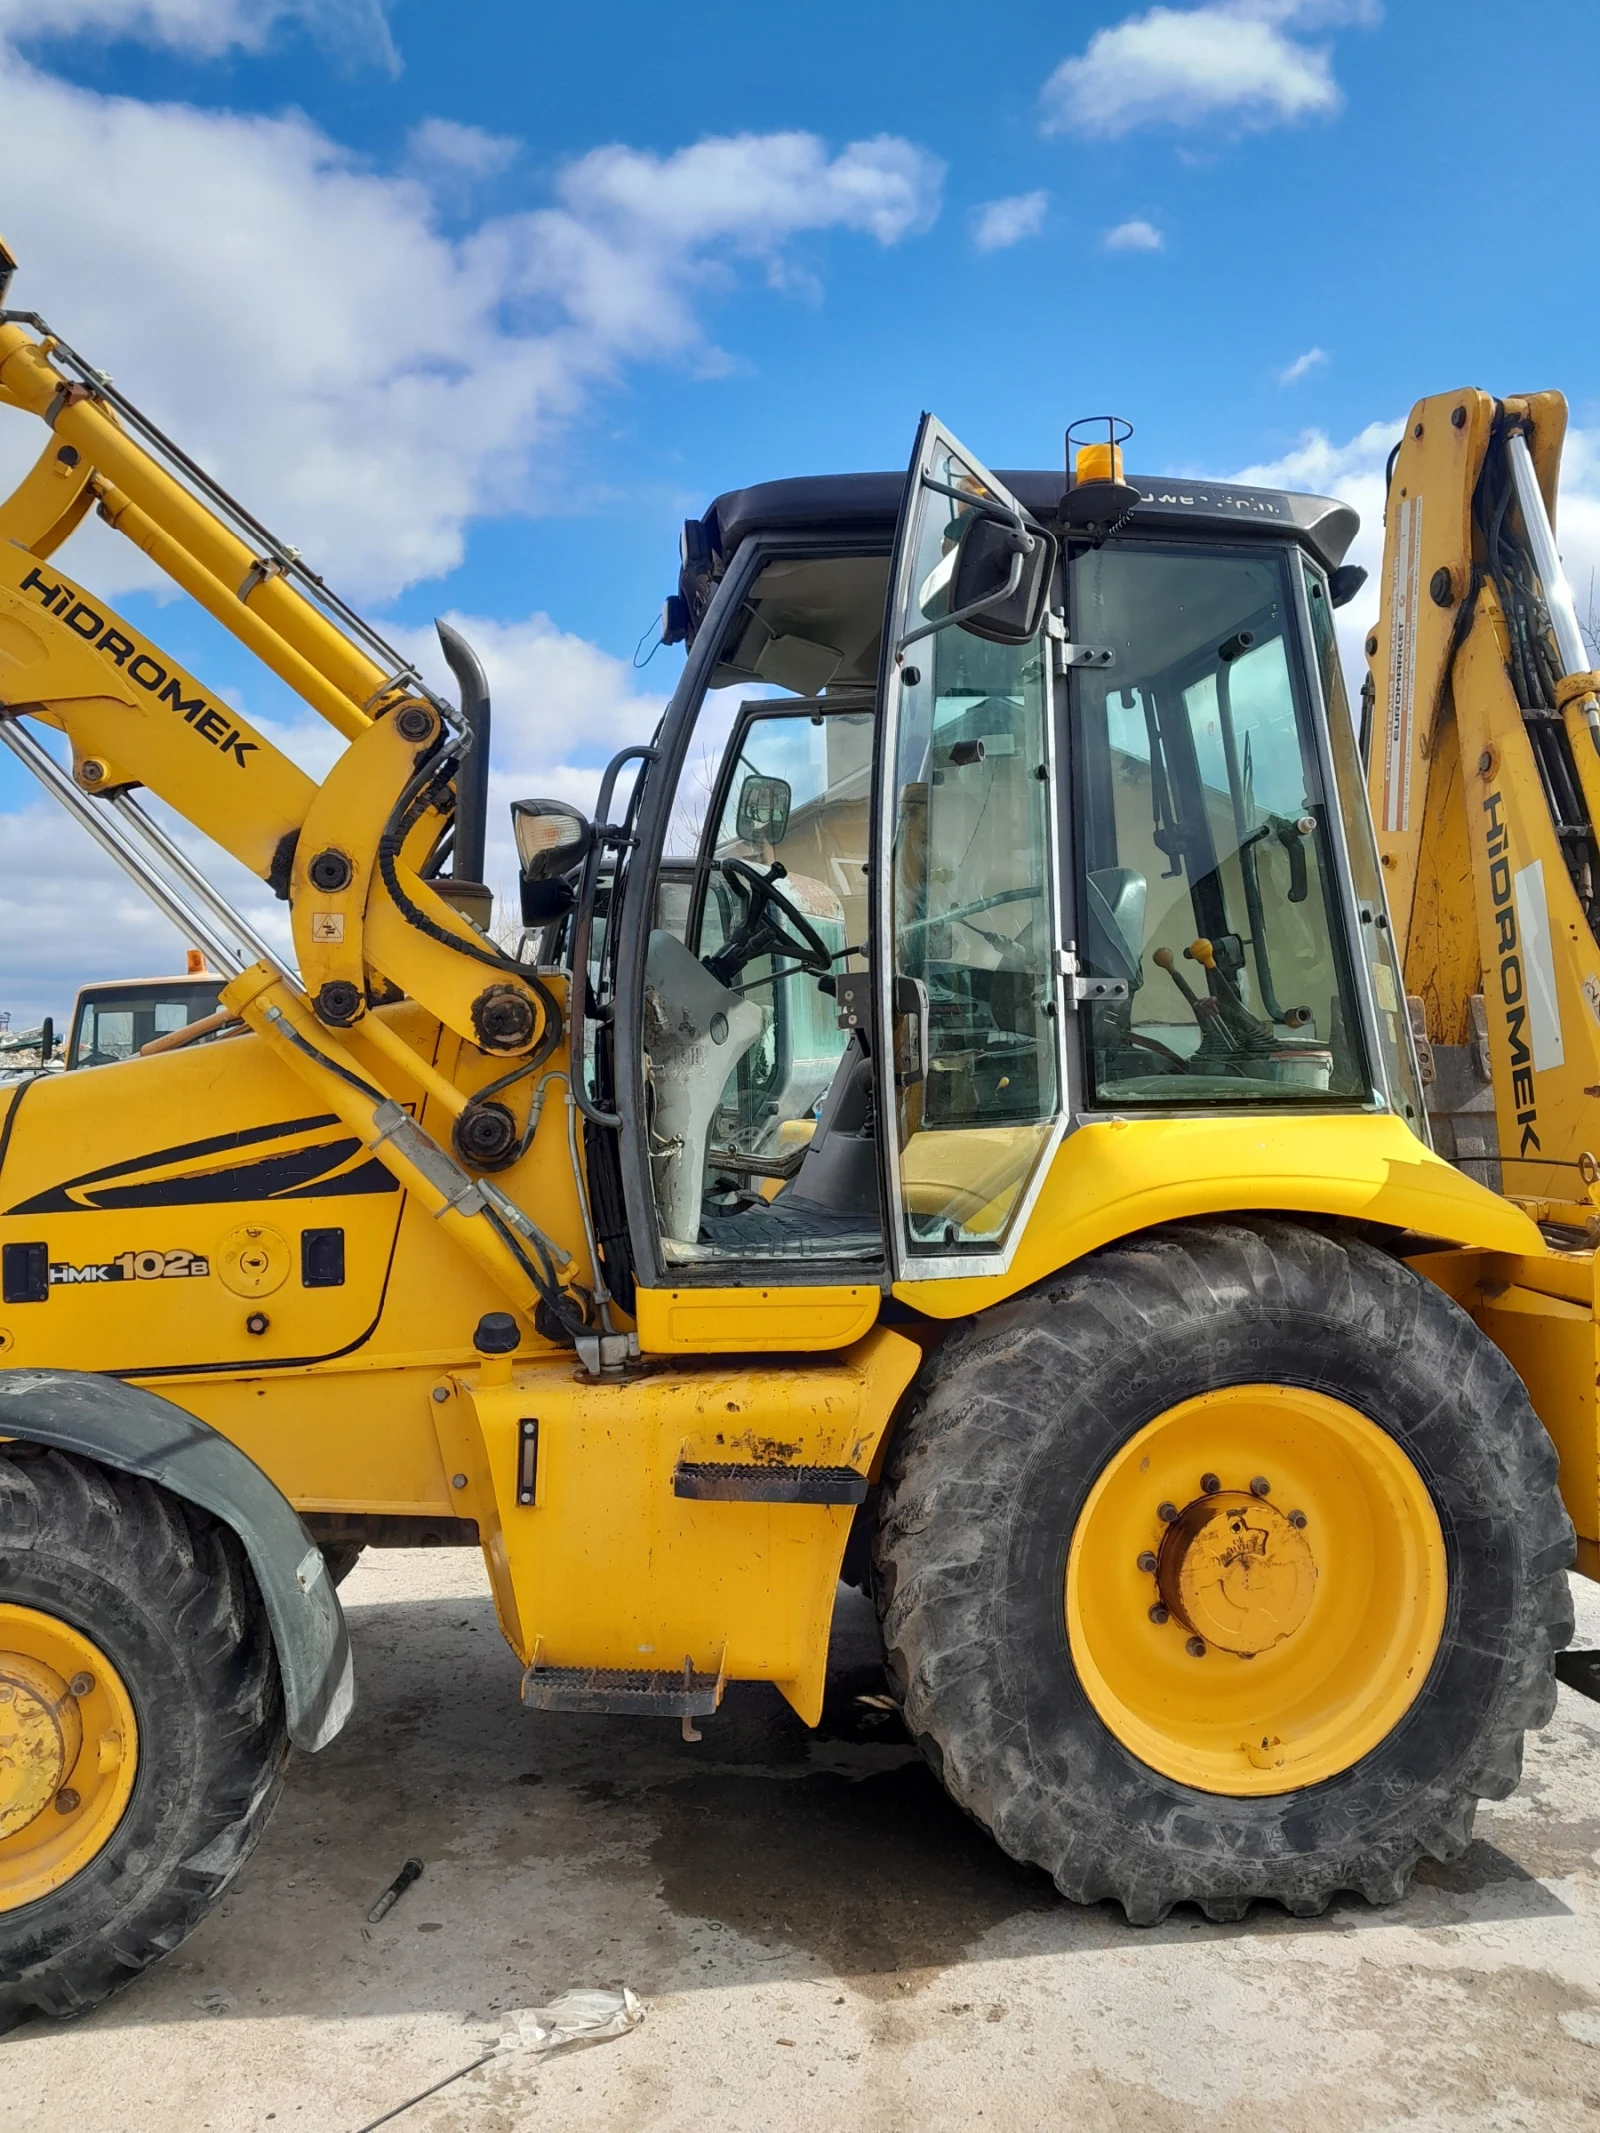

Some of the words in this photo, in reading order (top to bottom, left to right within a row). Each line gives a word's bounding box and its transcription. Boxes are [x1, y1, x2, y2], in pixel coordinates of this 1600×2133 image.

[1394, 622, 1404, 741] EUROMARKET
[1402, 621, 1411, 712] CONSTRUCTION
[49, 1265, 110, 1284] HMK
